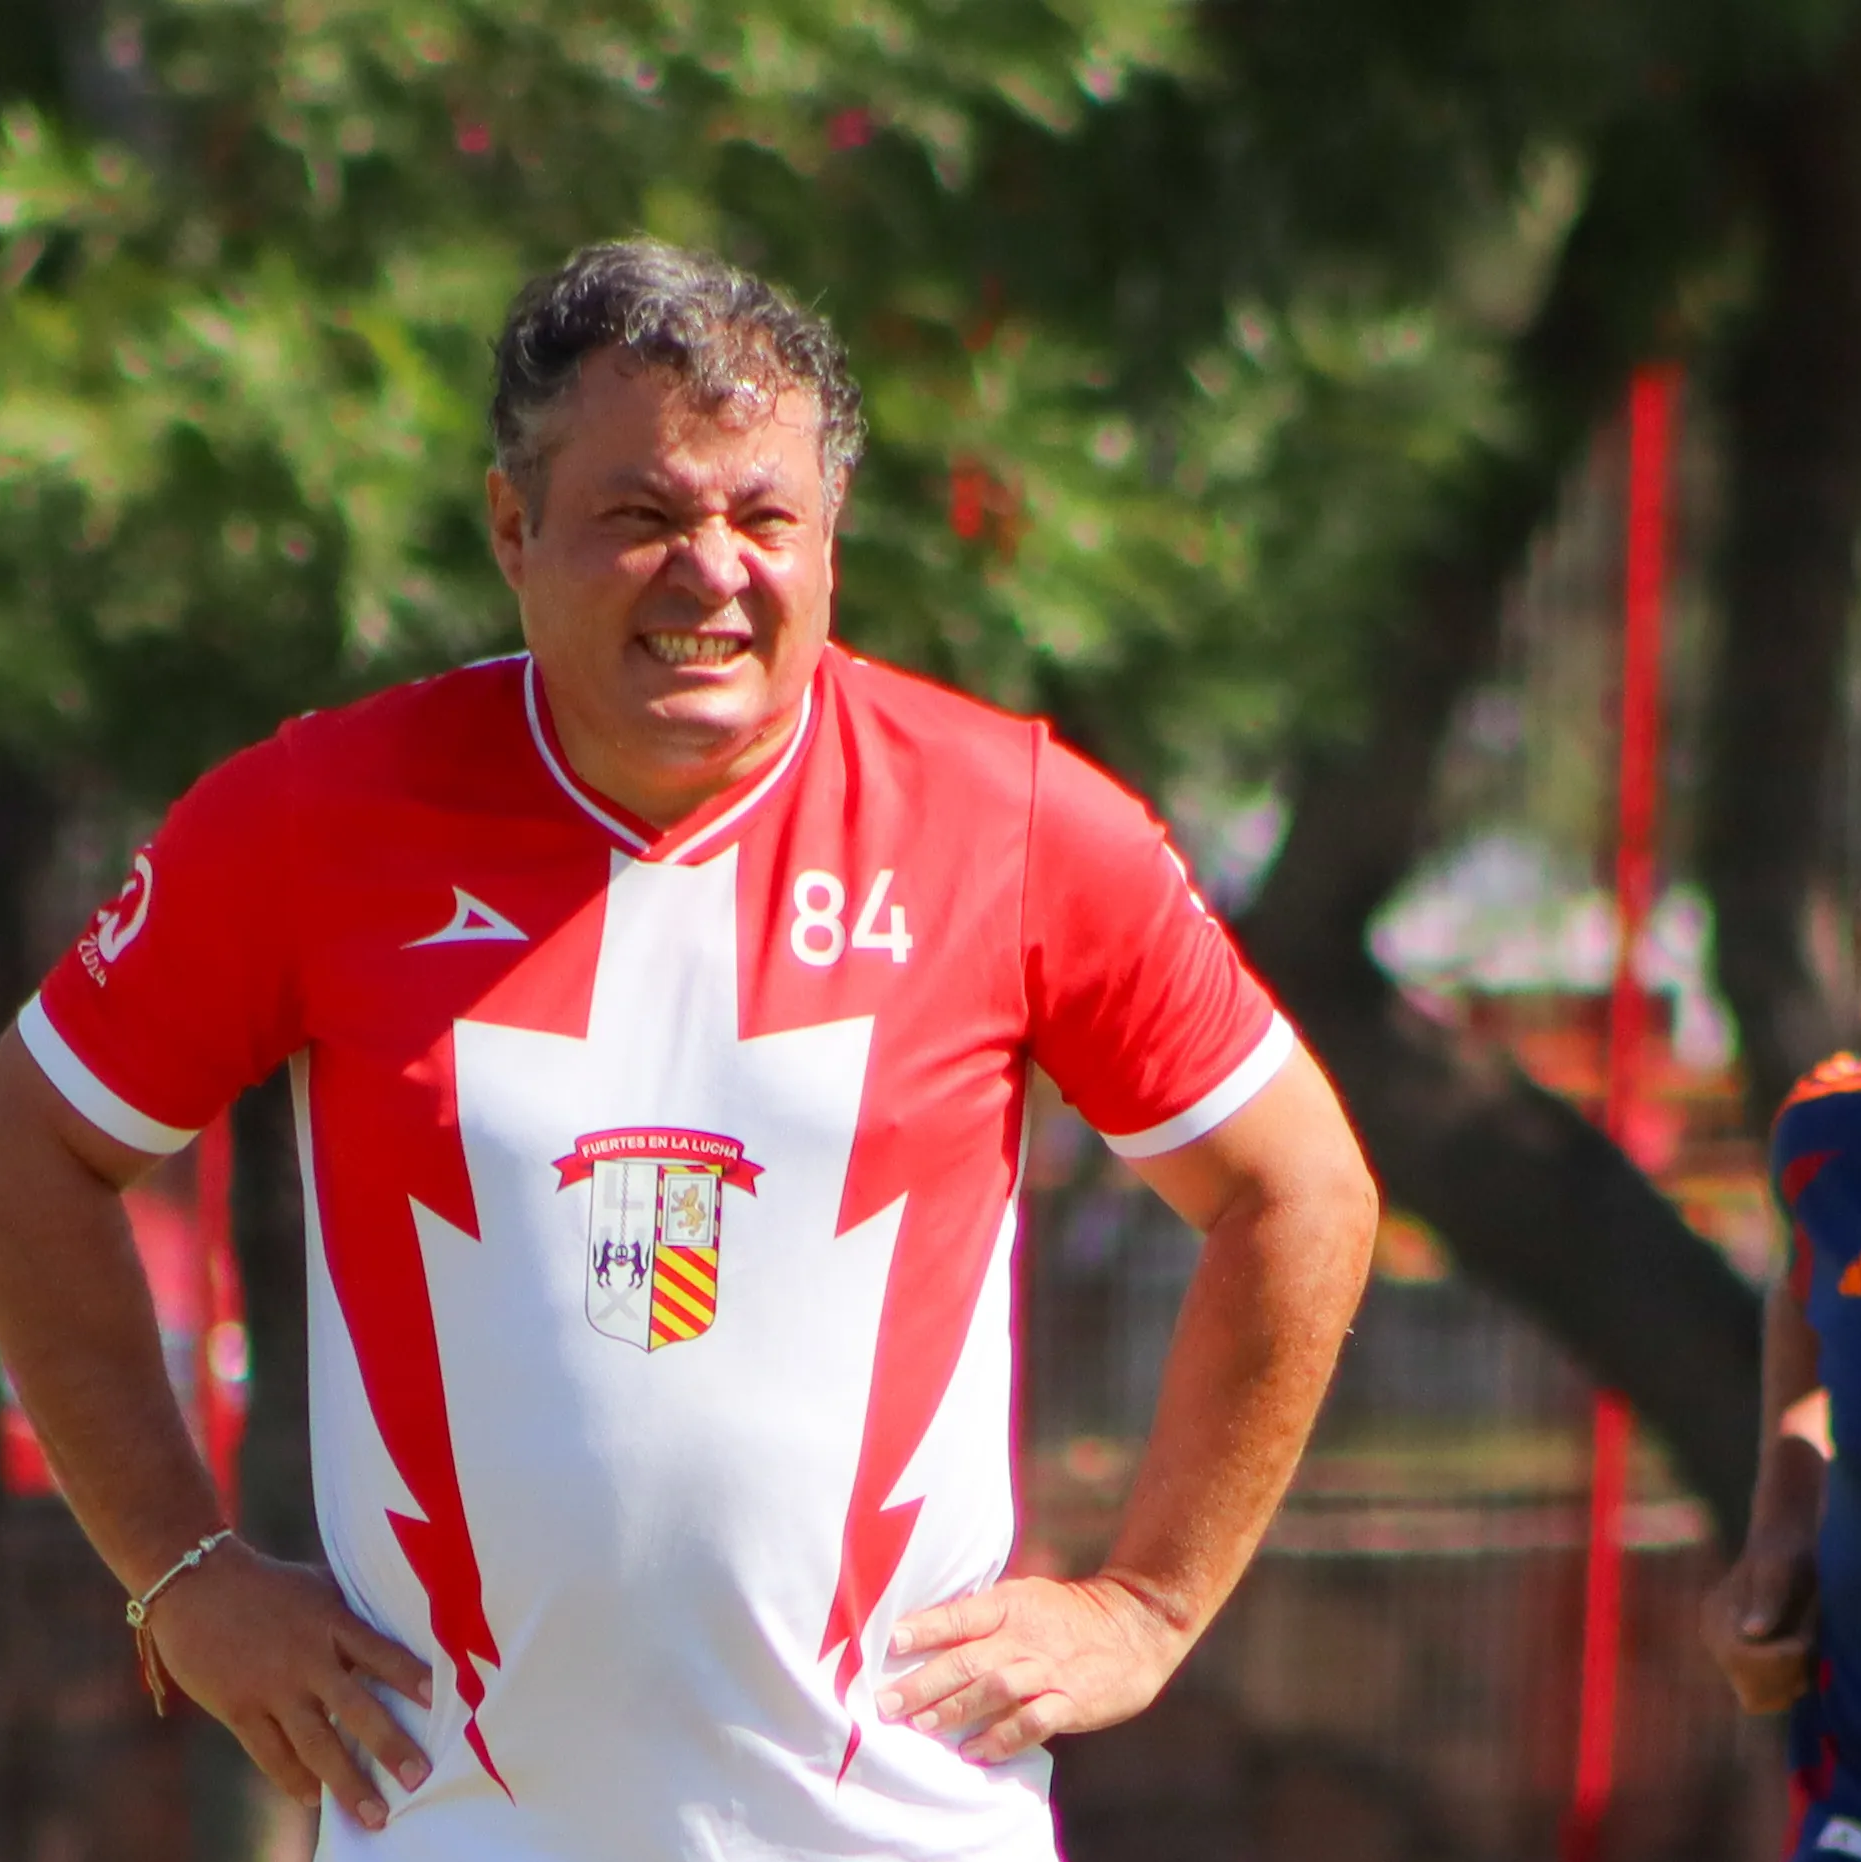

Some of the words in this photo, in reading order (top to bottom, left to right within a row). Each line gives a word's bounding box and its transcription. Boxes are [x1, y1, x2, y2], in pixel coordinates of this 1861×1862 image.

[791, 868, 914, 967] 84
[581, 1135, 646, 1158] FUERTES
[648, 1135, 668, 1149] EN
[671, 1137, 689, 1150] LA
[691, 1140, 738, 1160] LUCHA
